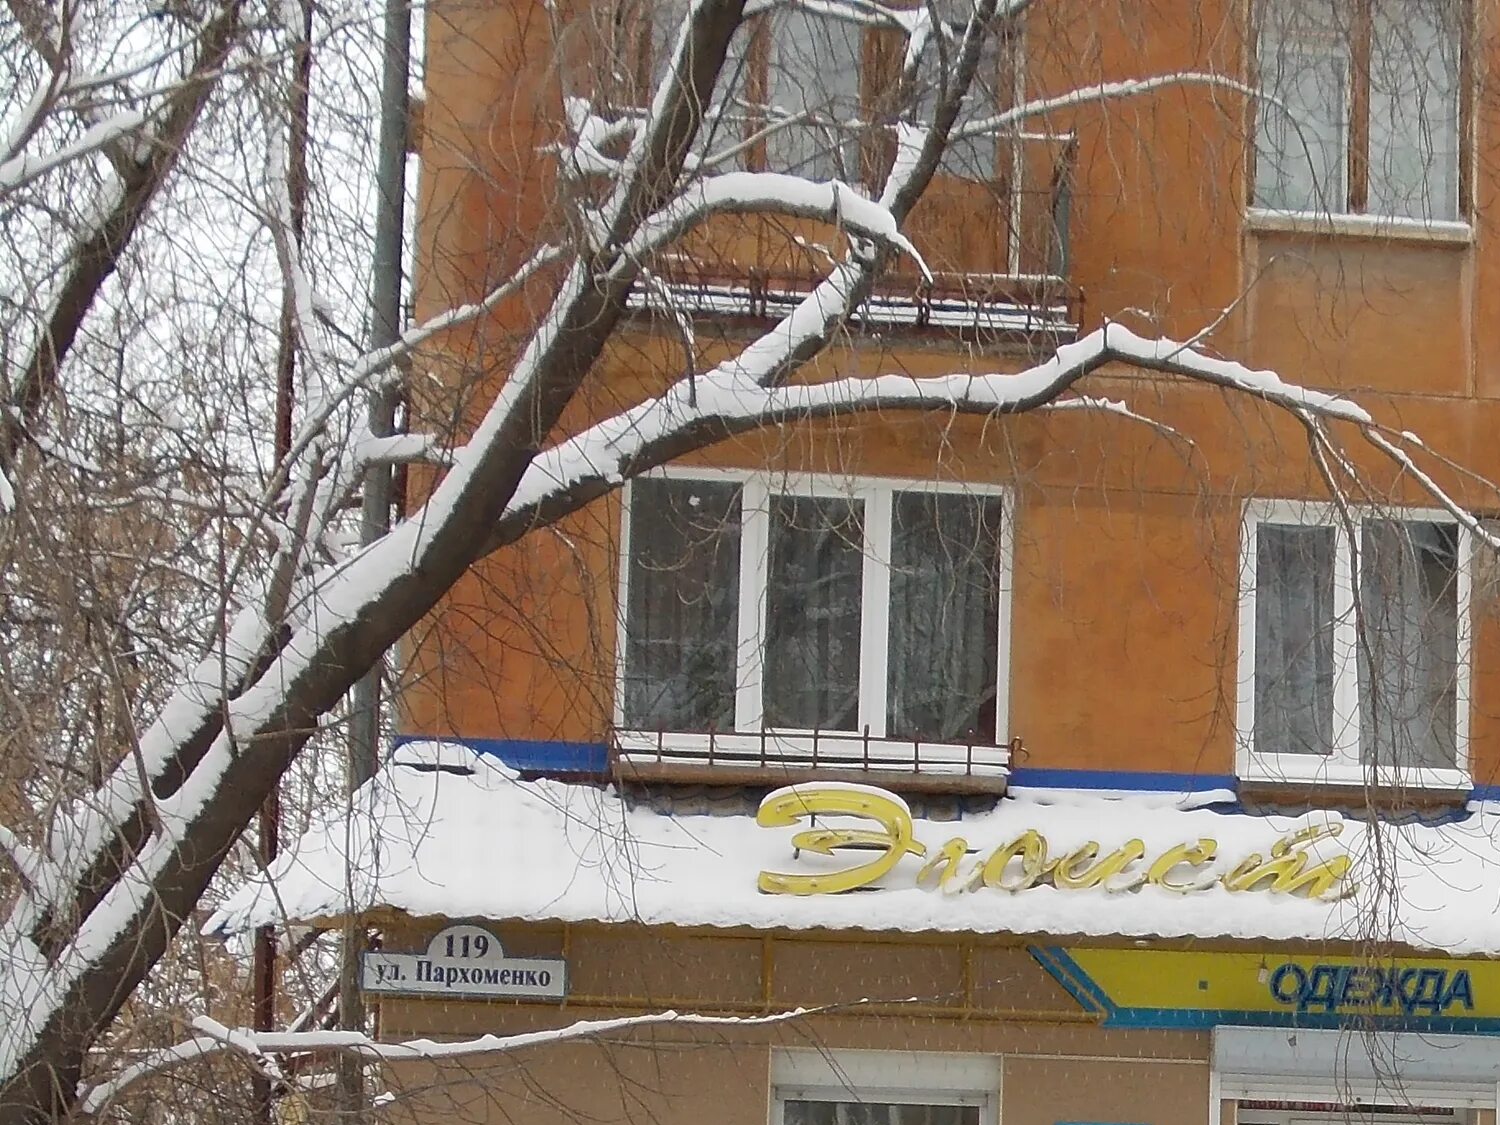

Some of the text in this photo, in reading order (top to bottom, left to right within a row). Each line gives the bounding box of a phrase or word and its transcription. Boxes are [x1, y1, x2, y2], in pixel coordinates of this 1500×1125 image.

[445, 934, 489, 958] 119
[376, 960, 551, 988] ул. Пархоменко
[1270, 963, 1474, 1016] ОДЕЖДА
